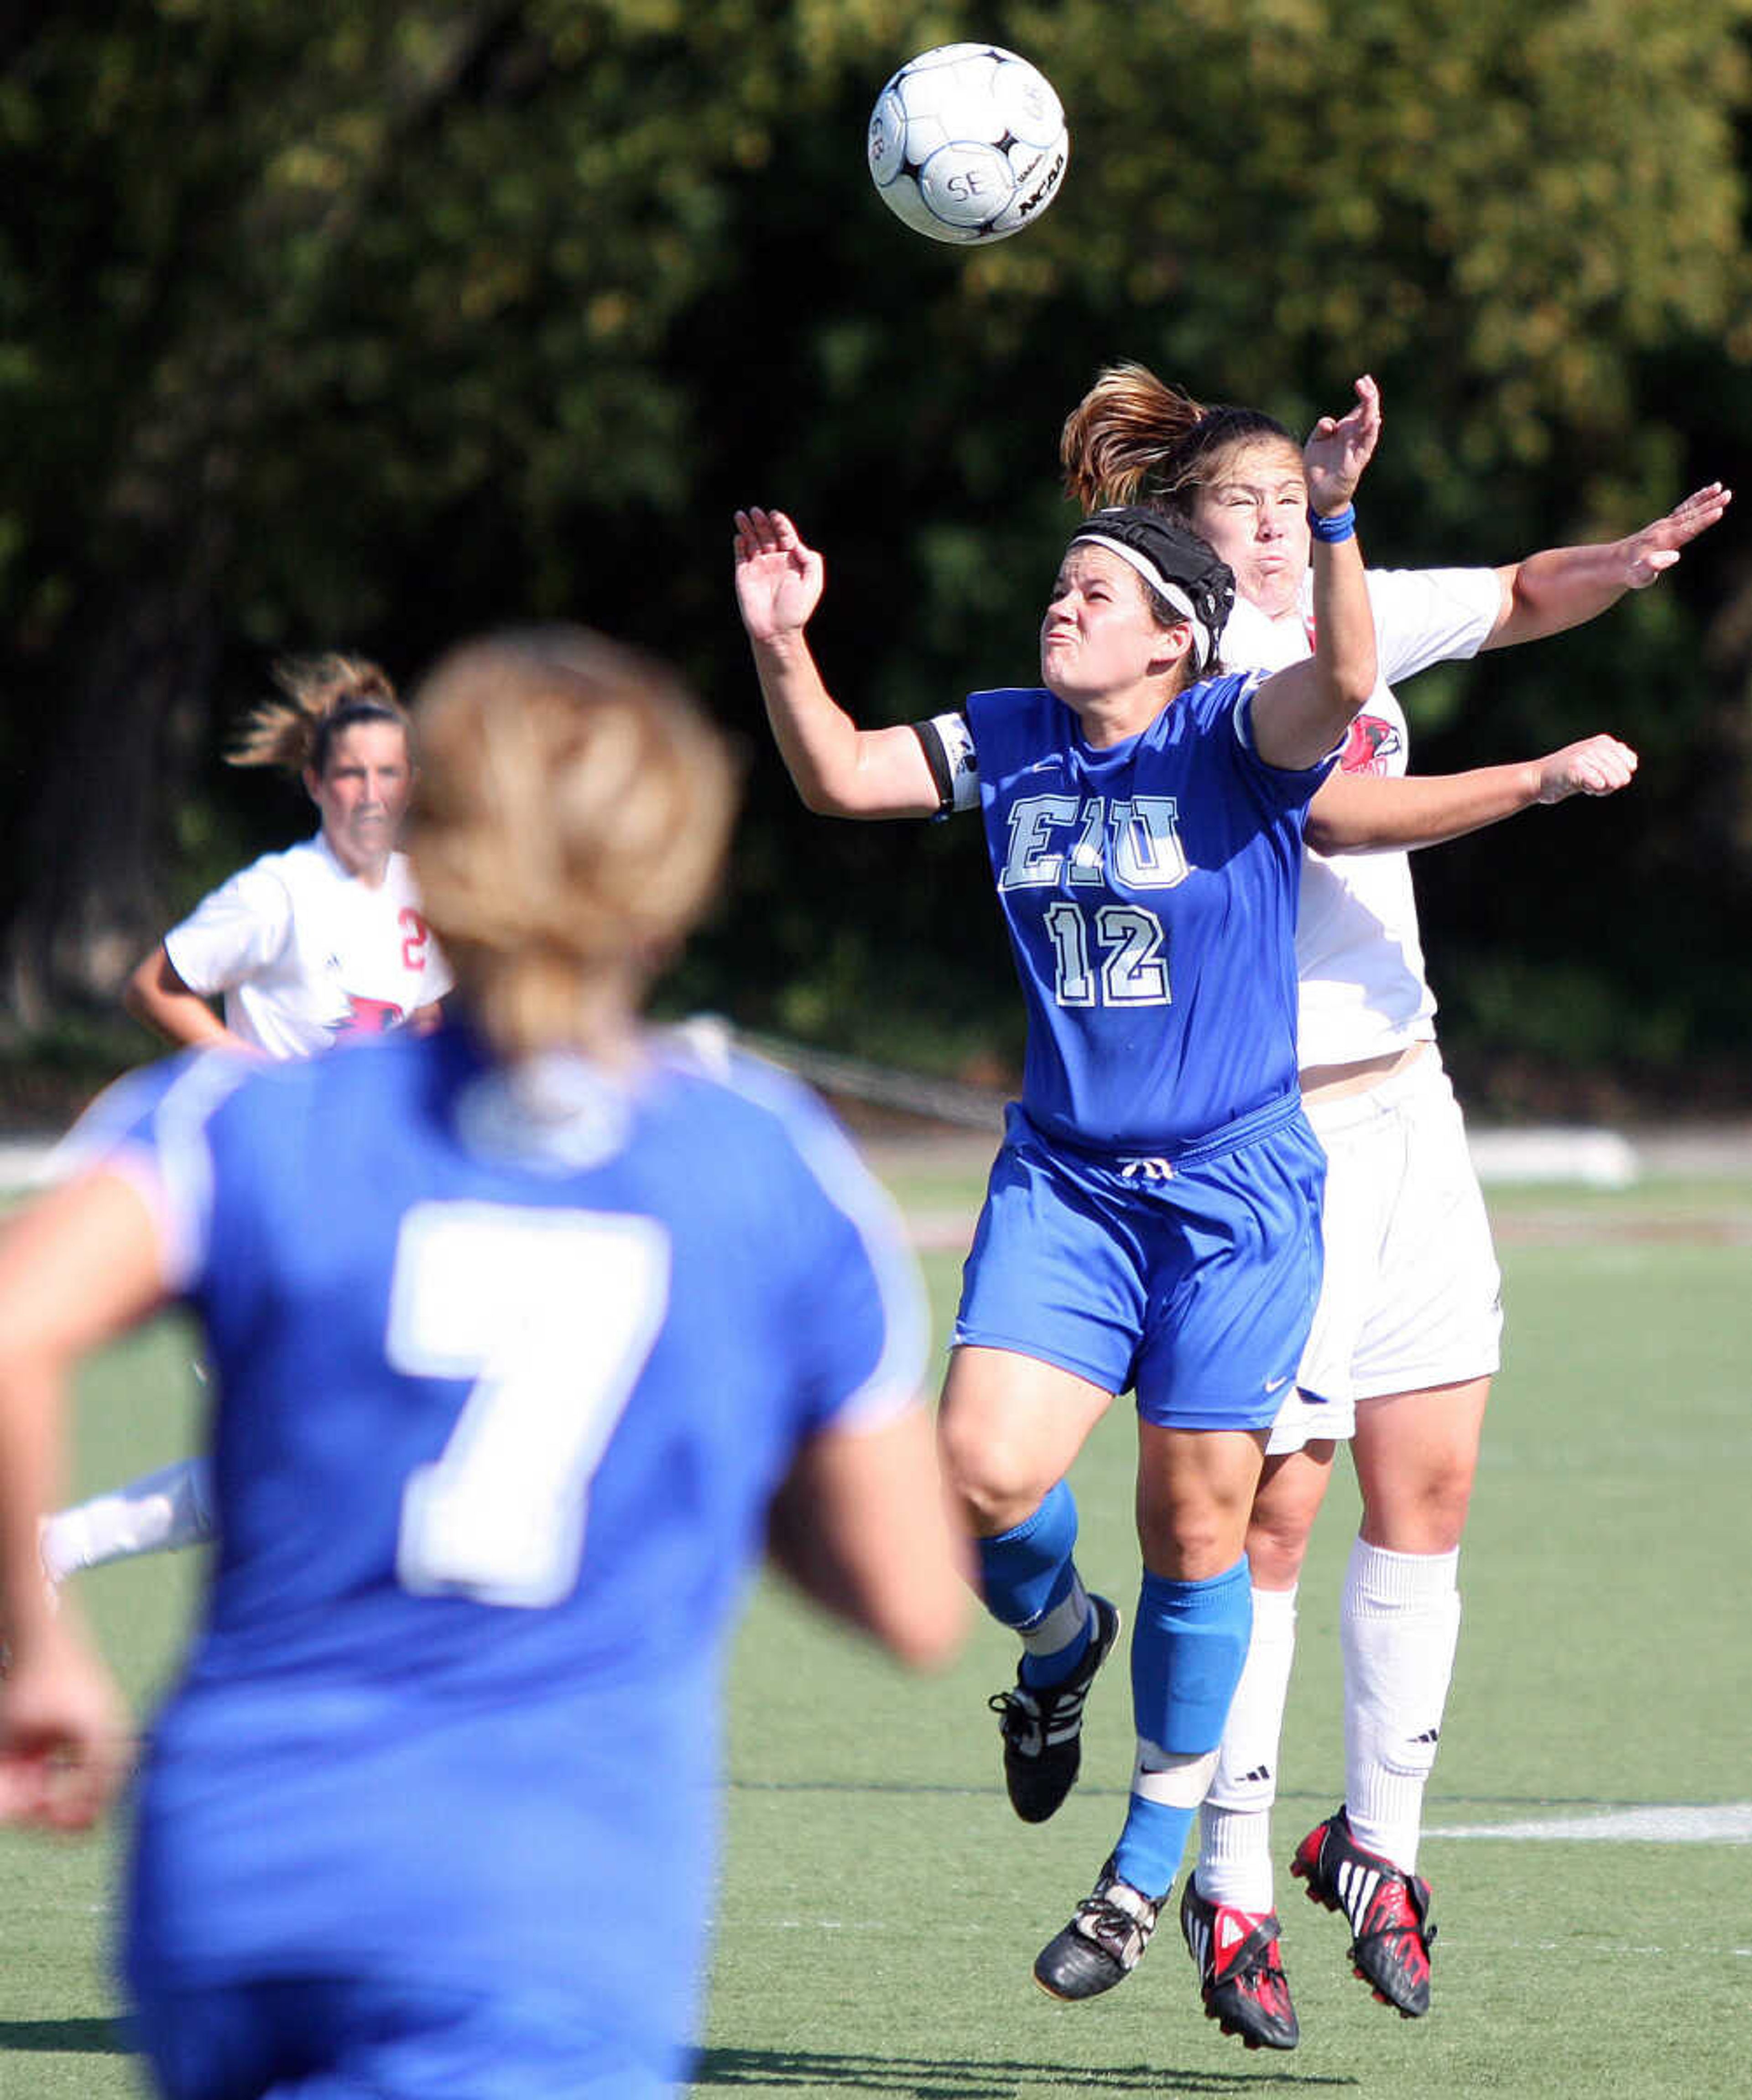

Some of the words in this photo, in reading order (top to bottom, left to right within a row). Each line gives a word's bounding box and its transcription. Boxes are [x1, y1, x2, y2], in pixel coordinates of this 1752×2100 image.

[947, 171, 984, 203] SE
[1018, 154, 1064, 218] NCAA
[997, 793, 1189, 891] EIU
[1043, 901, 1172, 1007] 12
[384, 1198, 673, 1610] 7
